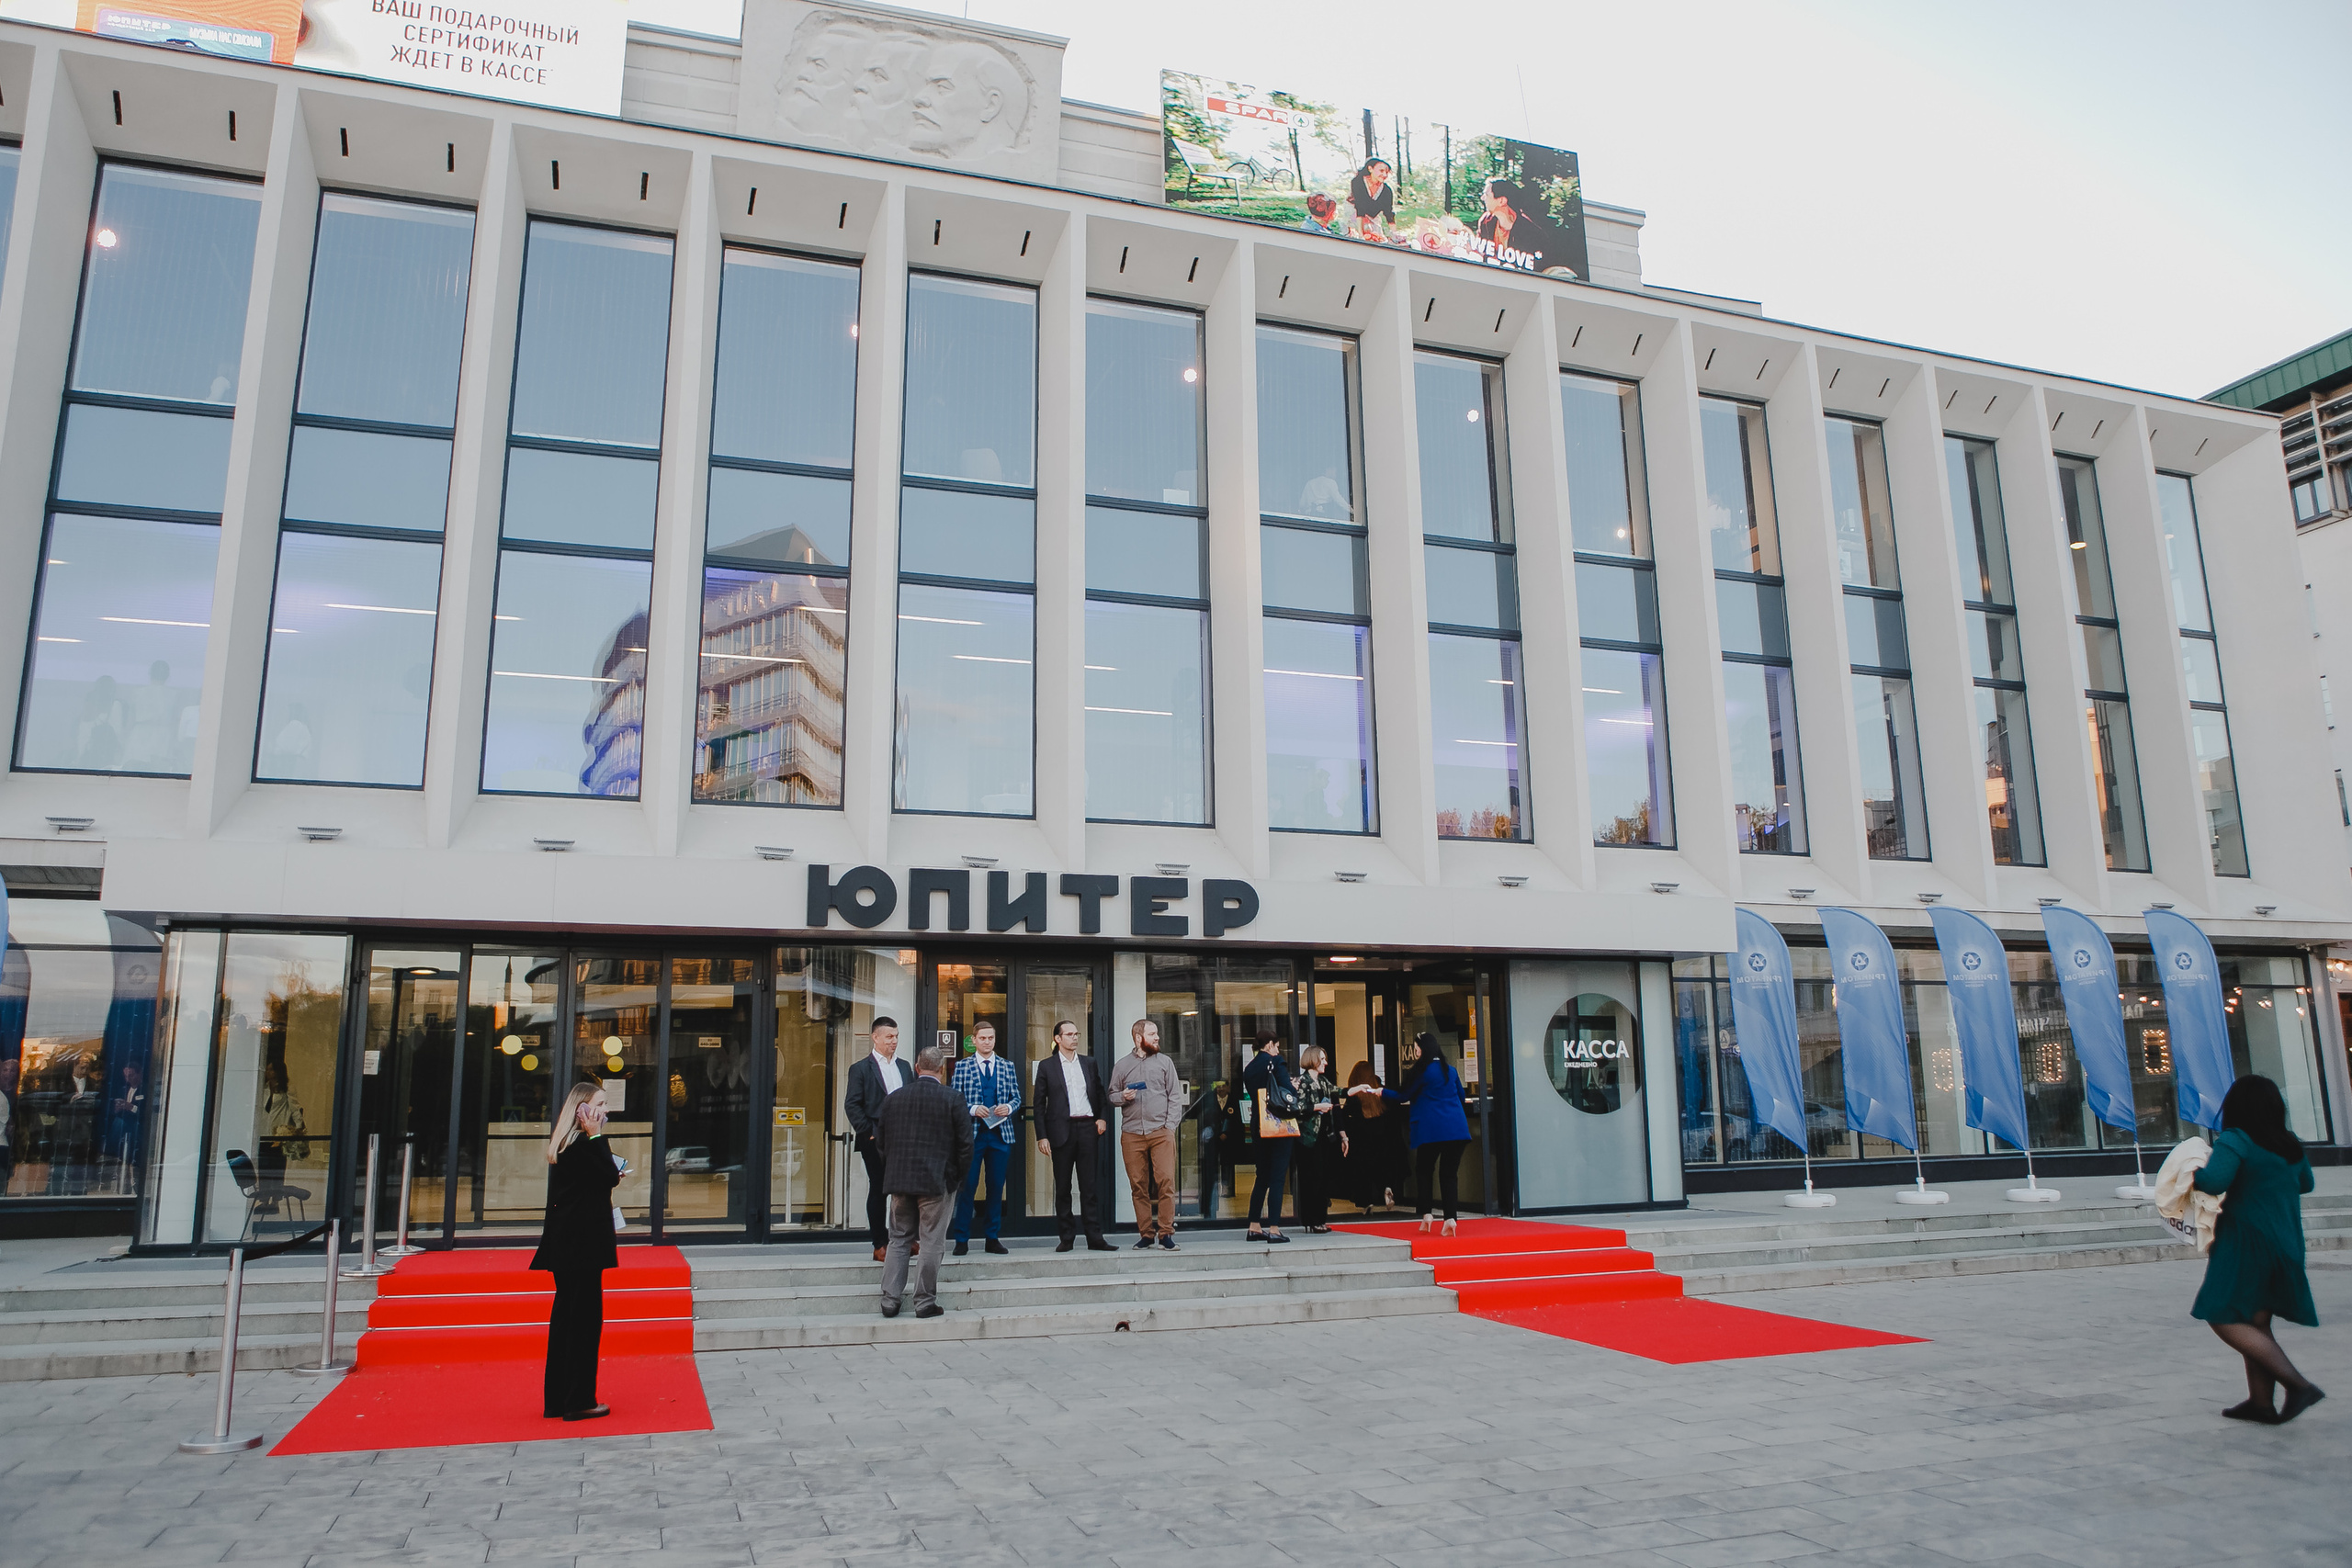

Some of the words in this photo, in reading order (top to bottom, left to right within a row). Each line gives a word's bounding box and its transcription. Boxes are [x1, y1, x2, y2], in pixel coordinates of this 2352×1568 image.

[107, 15, 172, 30] ЮПИТЕР
[219, 30, 232, 43] НАС
[372, 0, 421, 19] ВАШ
[430, 5, 580, 46] ПОДАРОЧНЫЙ
[404, 24, 545, 62] СЕРТИФИКАТ
[390, 44, 454, 70] ЖДЕТ
[461, 56, 473, 73] В
[481, 59, 547, 85] КАССЕ
[1225, 102, 1288, 123] SPAR
[807, 863, 1261, 937] ЮПИТЕР
[1563, 1040, 1630, 1059] КАССА
